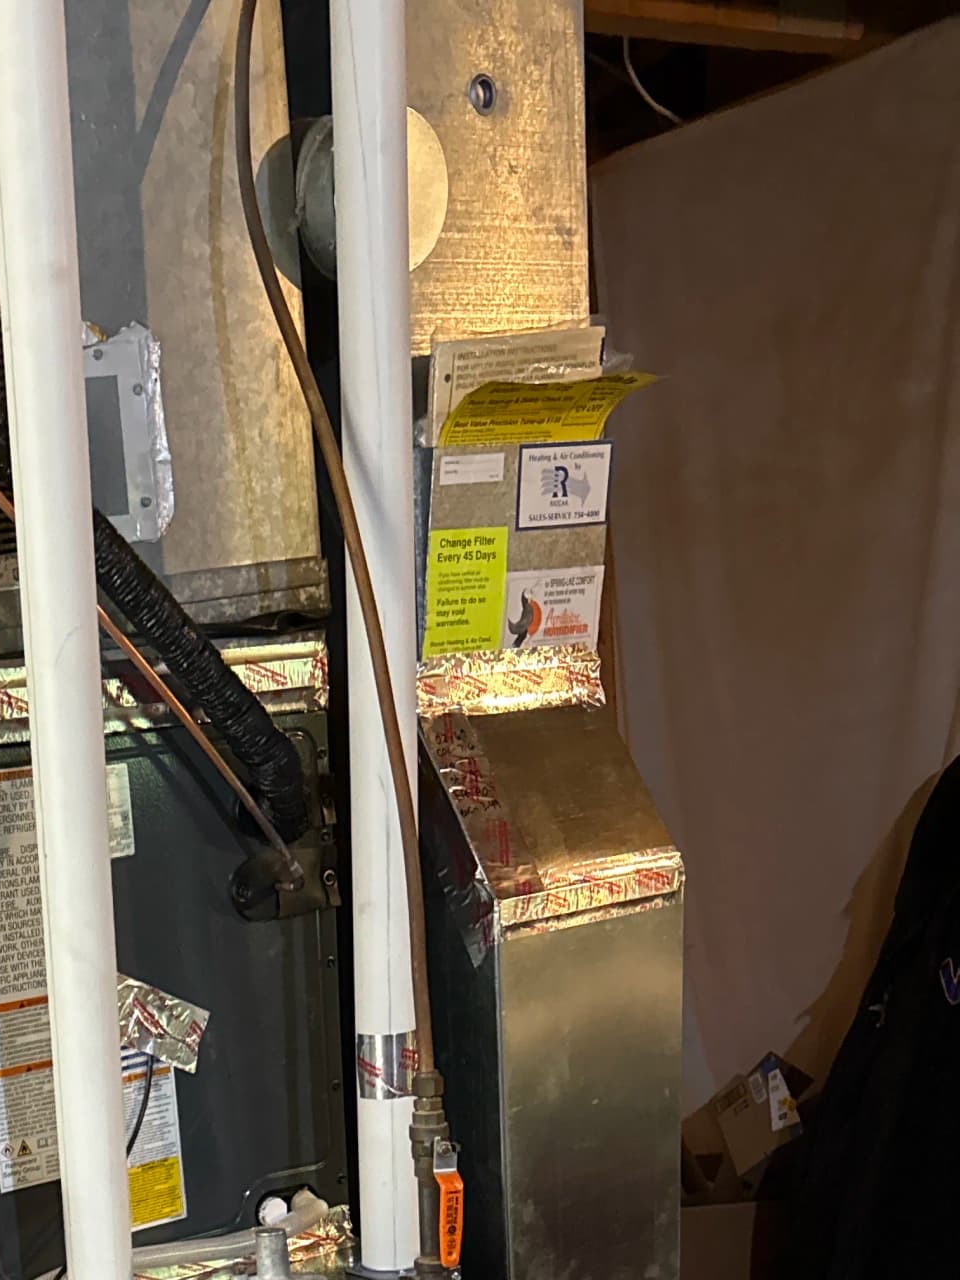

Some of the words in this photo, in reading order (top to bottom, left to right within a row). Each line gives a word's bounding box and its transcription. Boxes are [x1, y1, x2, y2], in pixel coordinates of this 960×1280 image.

[440, 538, 472, 549] Change
[474, 536, 496, 546] Filter
[437, 552, 461, 563] Every
[463, 552, 473, 561] 45
[475, 550, 497, 562] Days
[436, 597, 459, 607] Failure
[452, 608, 465, 616] void
[19, 801, 28, 811] BY
[7, 857, 14, 866] IN
[21, 866, 32, 875] OR
[21, 886, 40, 896] USED
[5, 910, 28, 921] WHICH
[3, 928, 40, 942] INSTALLED
[10, 962, 28, 972] WITH
[30, 959, 43, 968] THE
